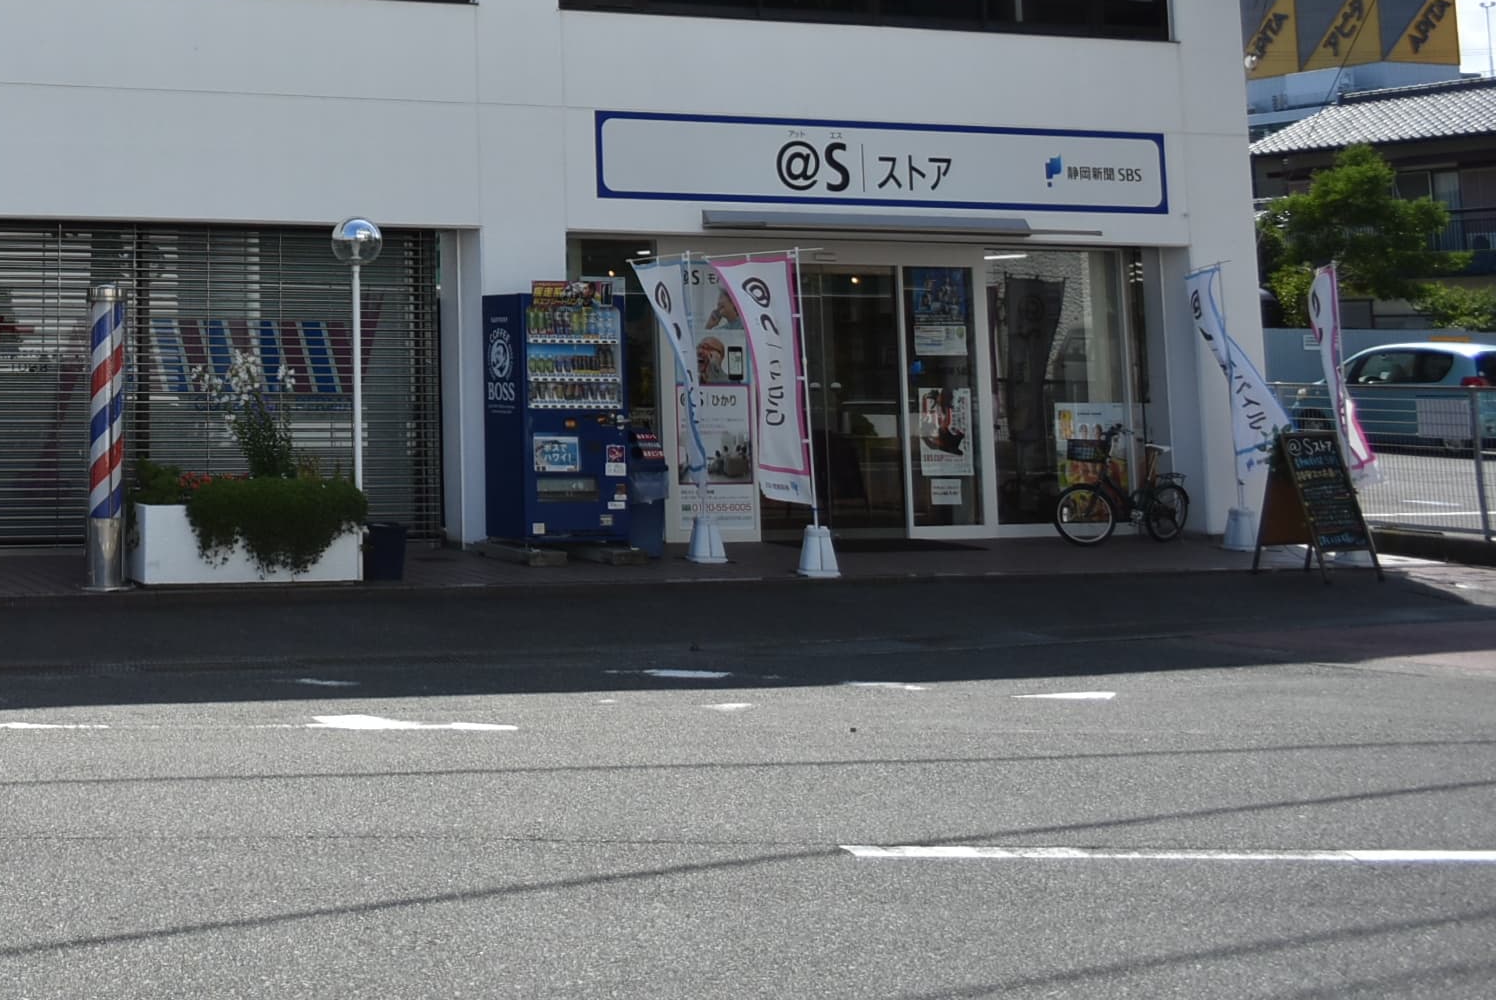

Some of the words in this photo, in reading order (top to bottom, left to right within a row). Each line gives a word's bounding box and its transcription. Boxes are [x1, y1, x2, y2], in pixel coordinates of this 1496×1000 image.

[787, 129, 806, 139] アット
[877, 154, 952, 192] ストア
[1067, 166, 1115, 181] 静岡新聞
[1117, 168, 1143, 182] SBS
[489, 328, 511, 342] COFFEE
[488, 382, 516, 401] BOSS
[711, 394, 737, 407] ひかり
